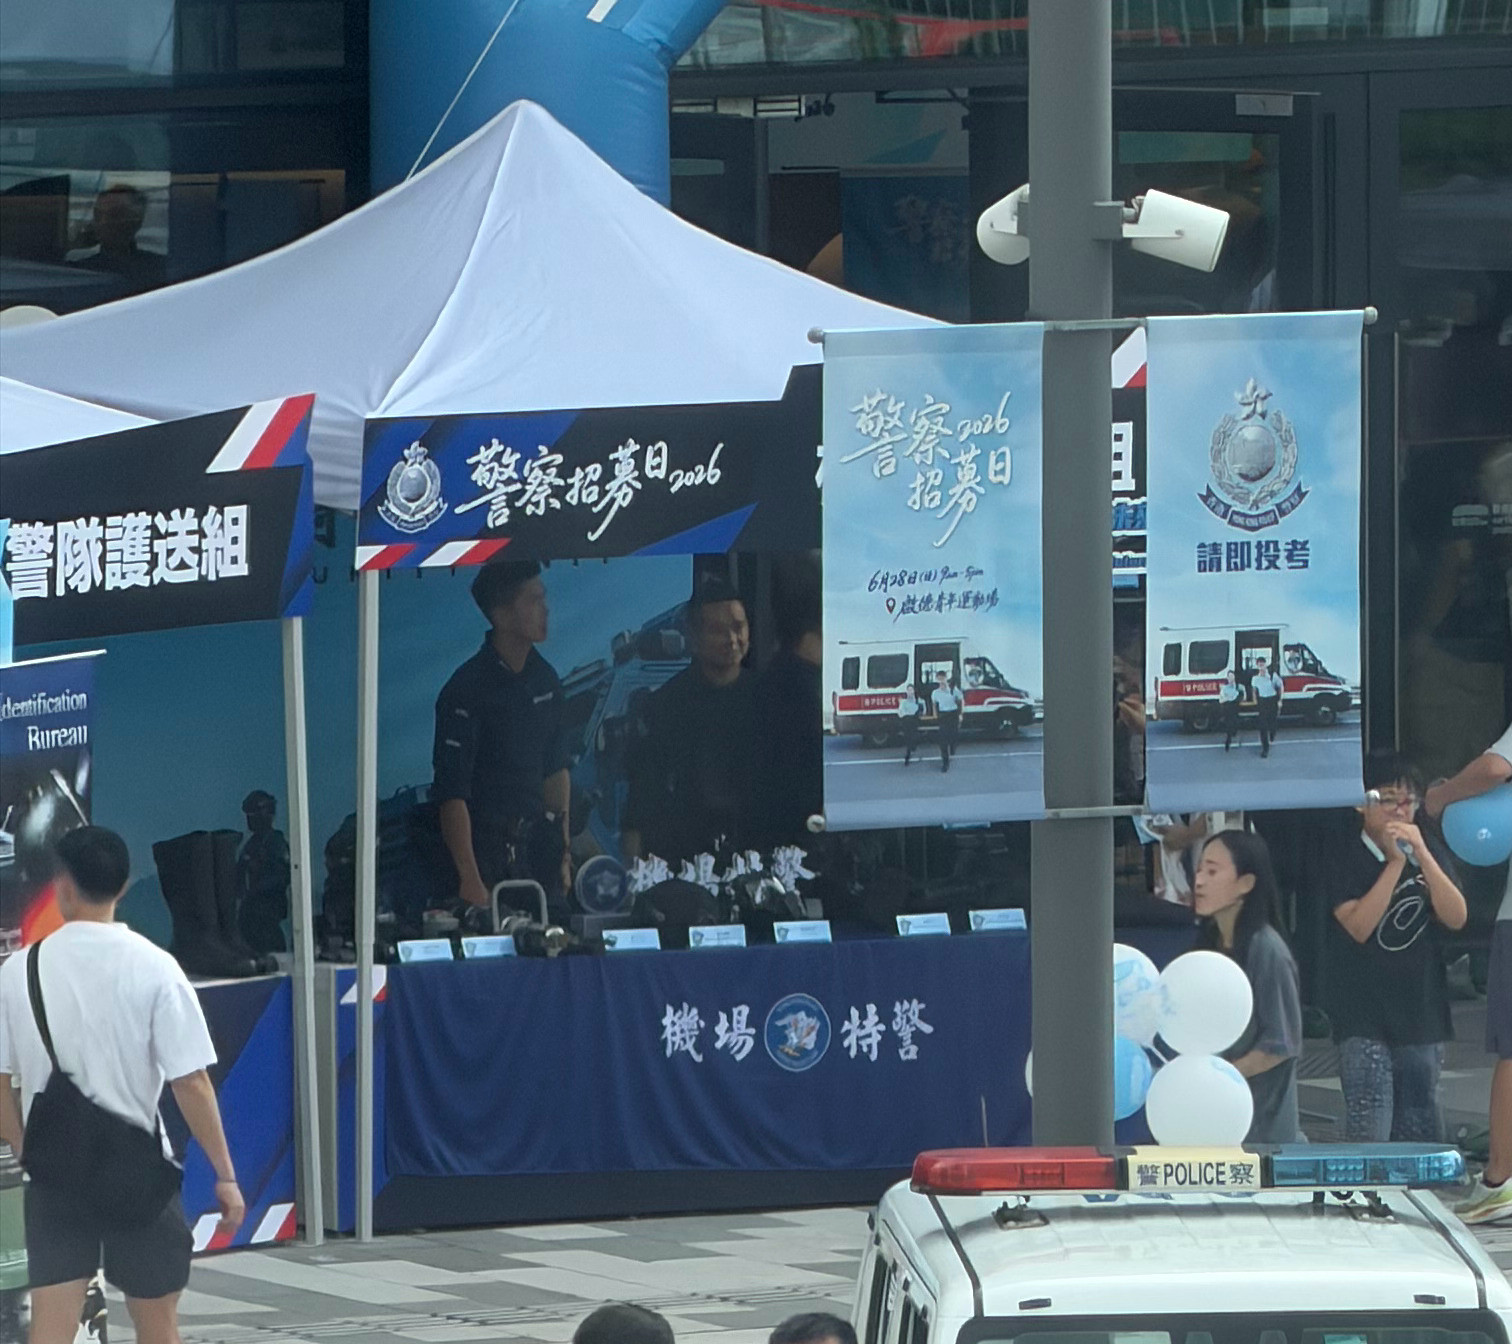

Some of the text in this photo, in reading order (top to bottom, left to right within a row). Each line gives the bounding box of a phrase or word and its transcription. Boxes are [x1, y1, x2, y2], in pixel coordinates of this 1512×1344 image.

[5, 503, 250, 601] 警隊護送組
[1196, 539, 1310, 573] 請即投考
[27, 725, 88, 751] Bureau
[661, 999, 934, 1063] 機場 特警
[1163, 1161, 1227, 1186] POLICE
